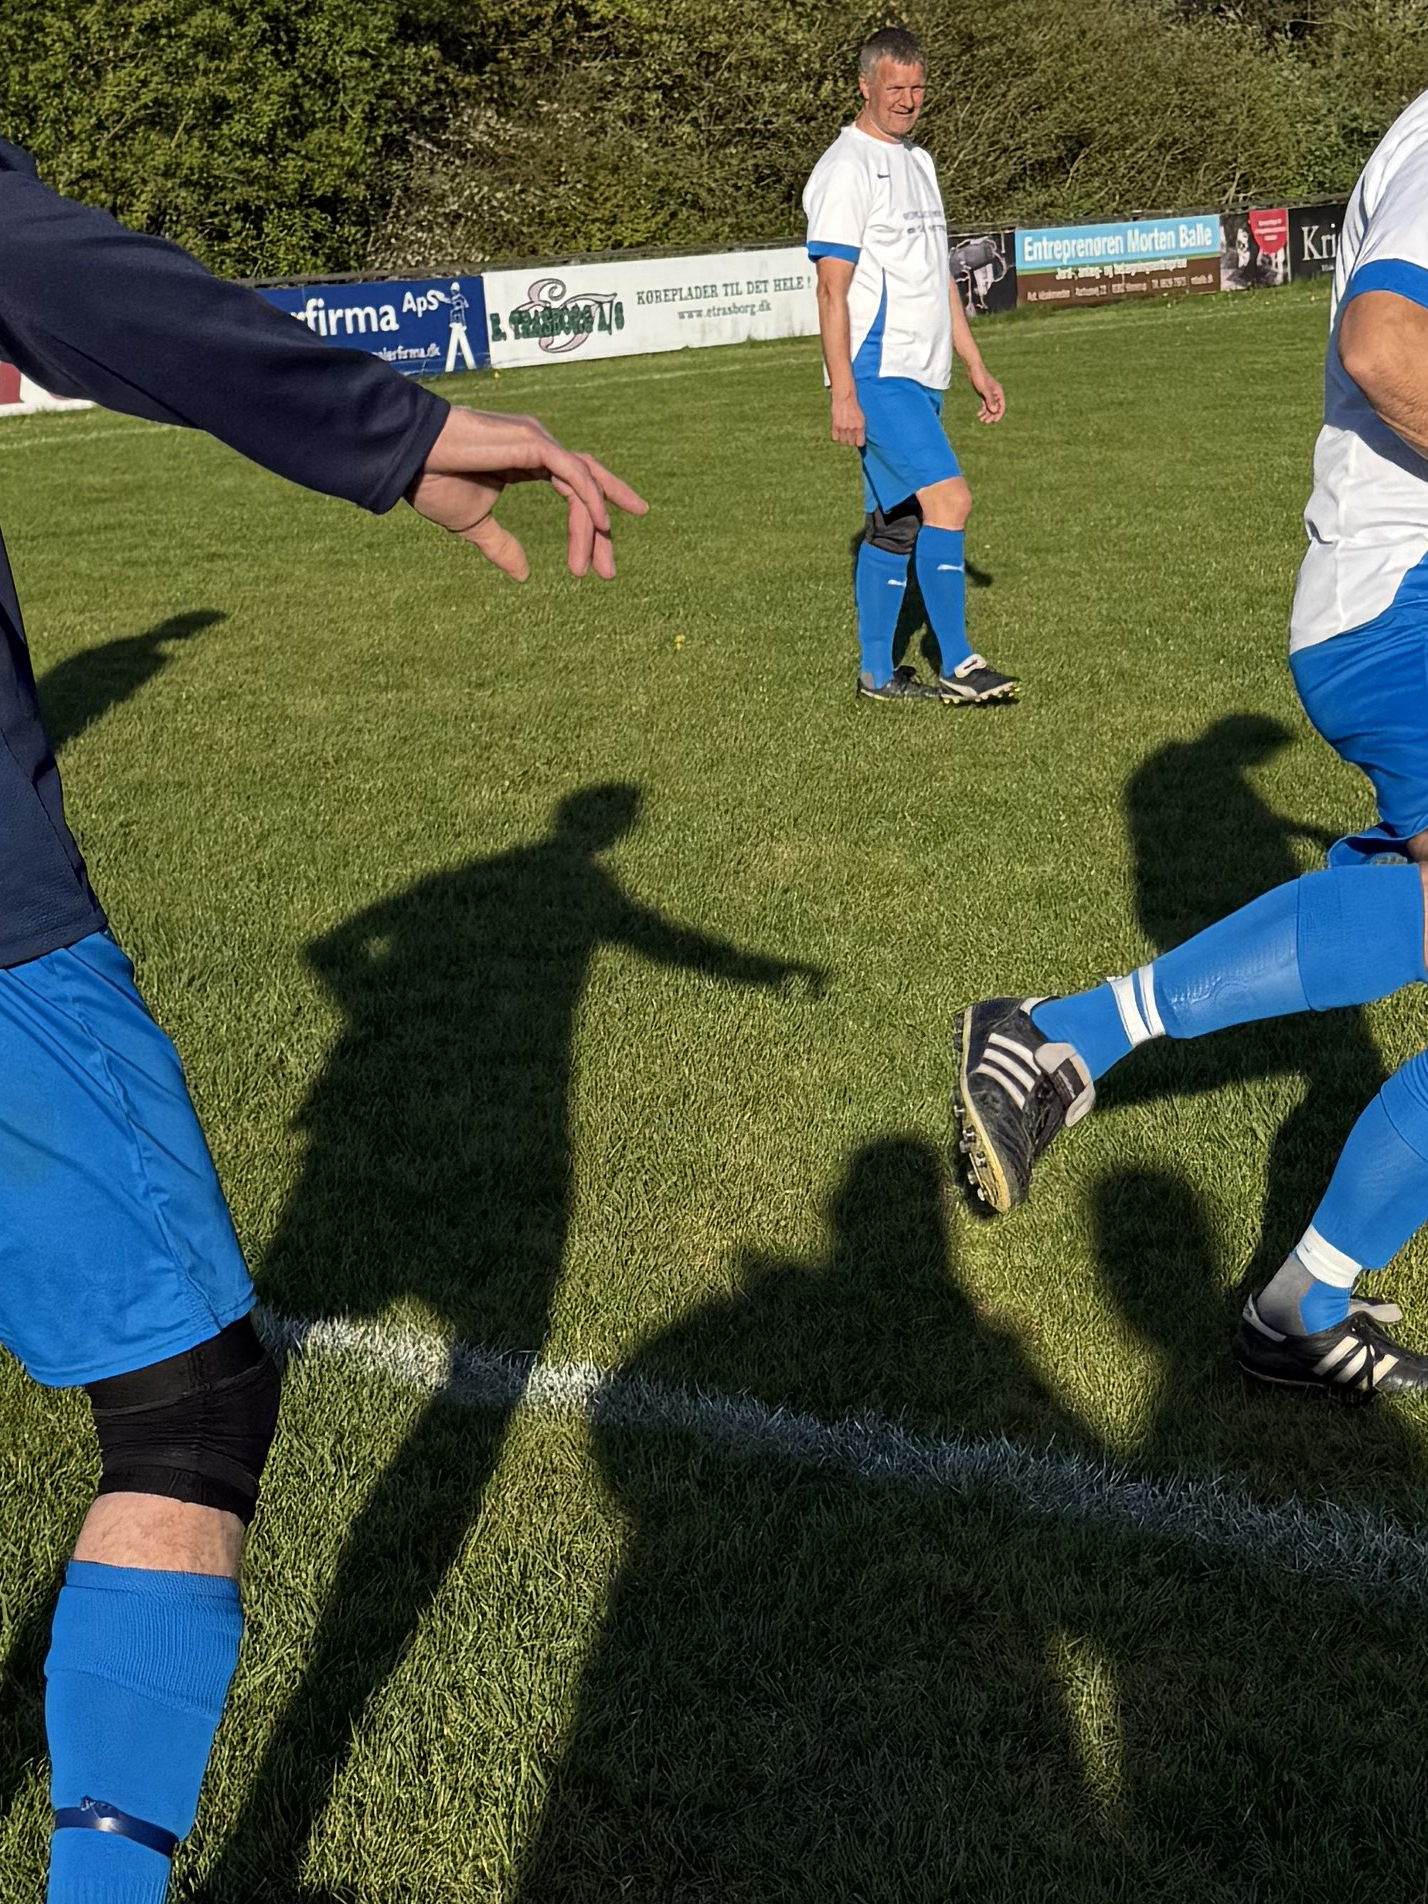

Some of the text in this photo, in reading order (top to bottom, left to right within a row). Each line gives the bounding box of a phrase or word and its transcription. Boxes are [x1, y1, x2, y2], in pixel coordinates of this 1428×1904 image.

[1024, 223, 1212, 264] Entreprenøren Morten Balle
[1301, 223, 1336, 261] Kri
[722, 281, 743, 297] TIL
[746, 280, 769, 295] DET
[773, 276, 804, 292] HELE
[402, 289, 440, 318] ApS
